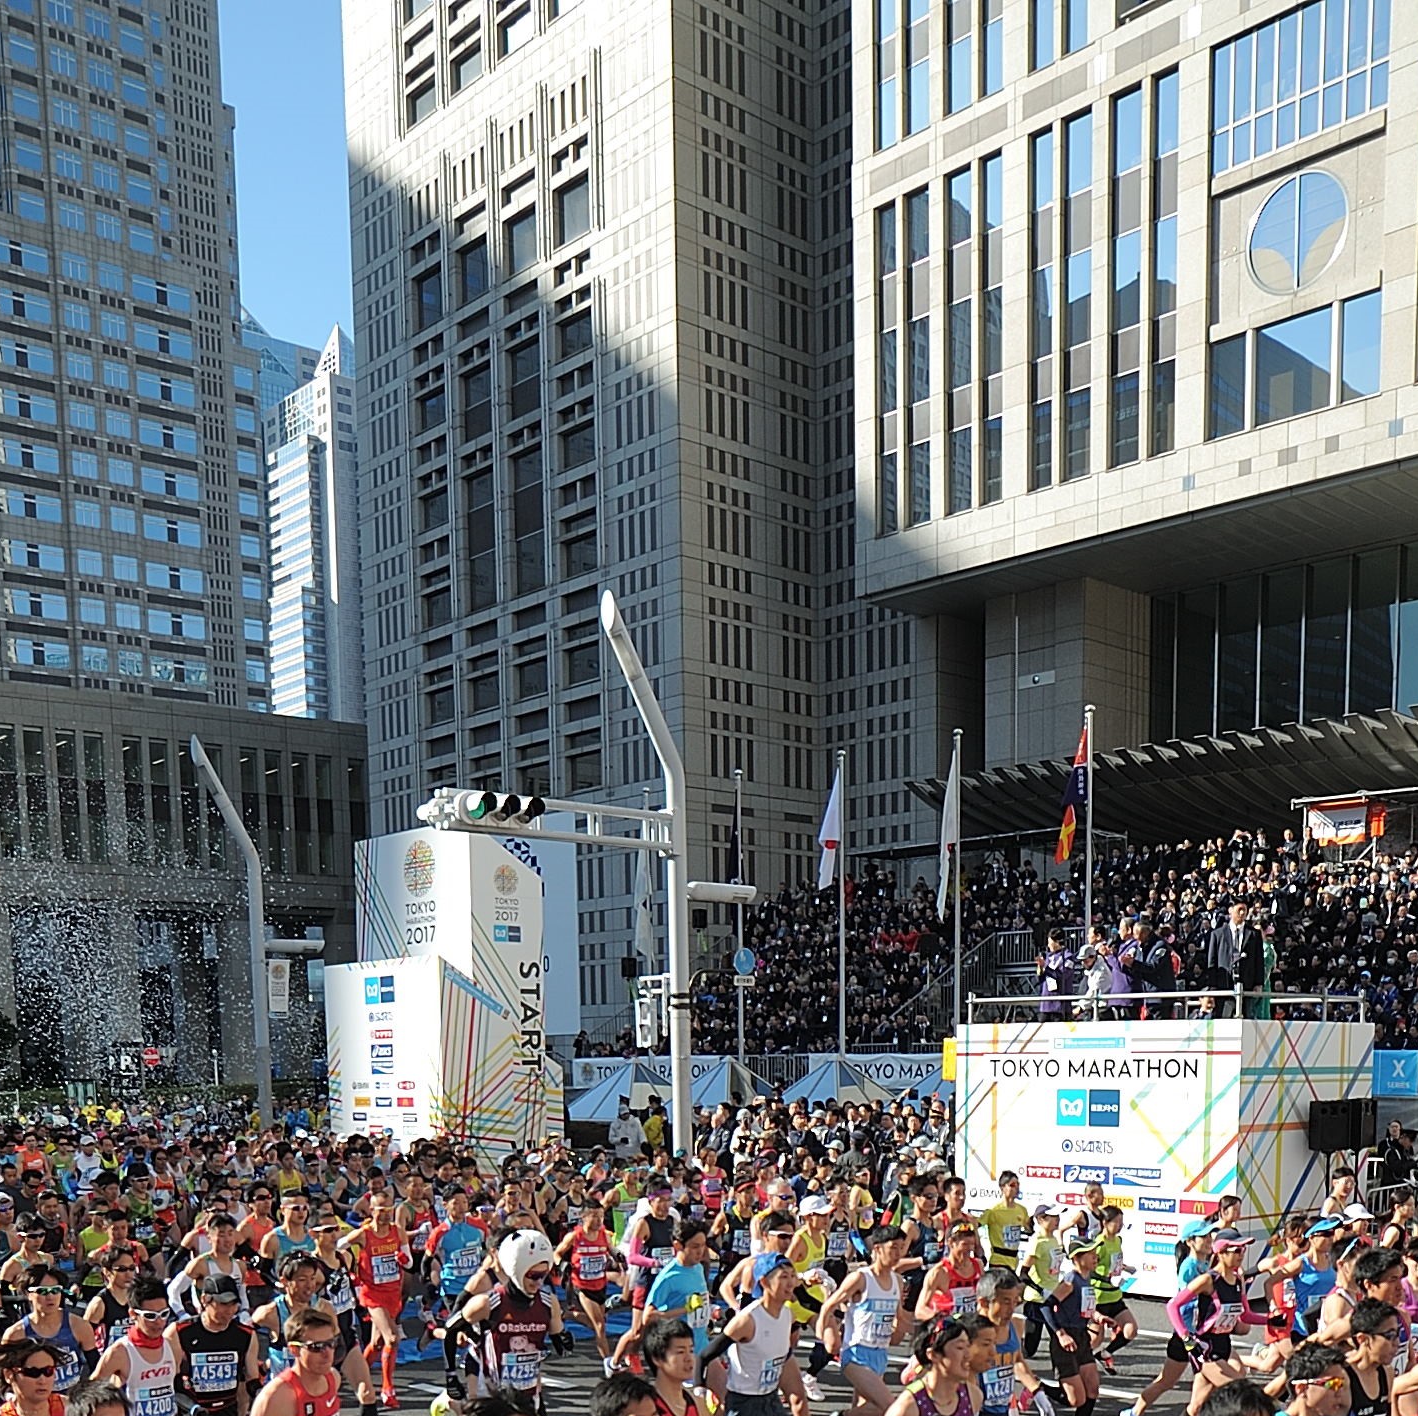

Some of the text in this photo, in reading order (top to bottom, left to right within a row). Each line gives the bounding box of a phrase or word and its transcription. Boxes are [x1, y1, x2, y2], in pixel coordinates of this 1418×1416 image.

[406, 901, 436, 915] TOKYO
[495, 897, 519, 906] TOKYO
[495, 911, 519, 922] 2017
[407, 926, 436, 945] 2017
[519, 961, 543, 1072] START
[990, 1058, 1199, 1079] TOKYO MARATHON
[1392, 1058, 1405, 1078] X
[508, 1322, 547, 1333] Rakuten
[193, 1365, 231, 1380] A4549
[136, 1398, 172, 1416] A4200
